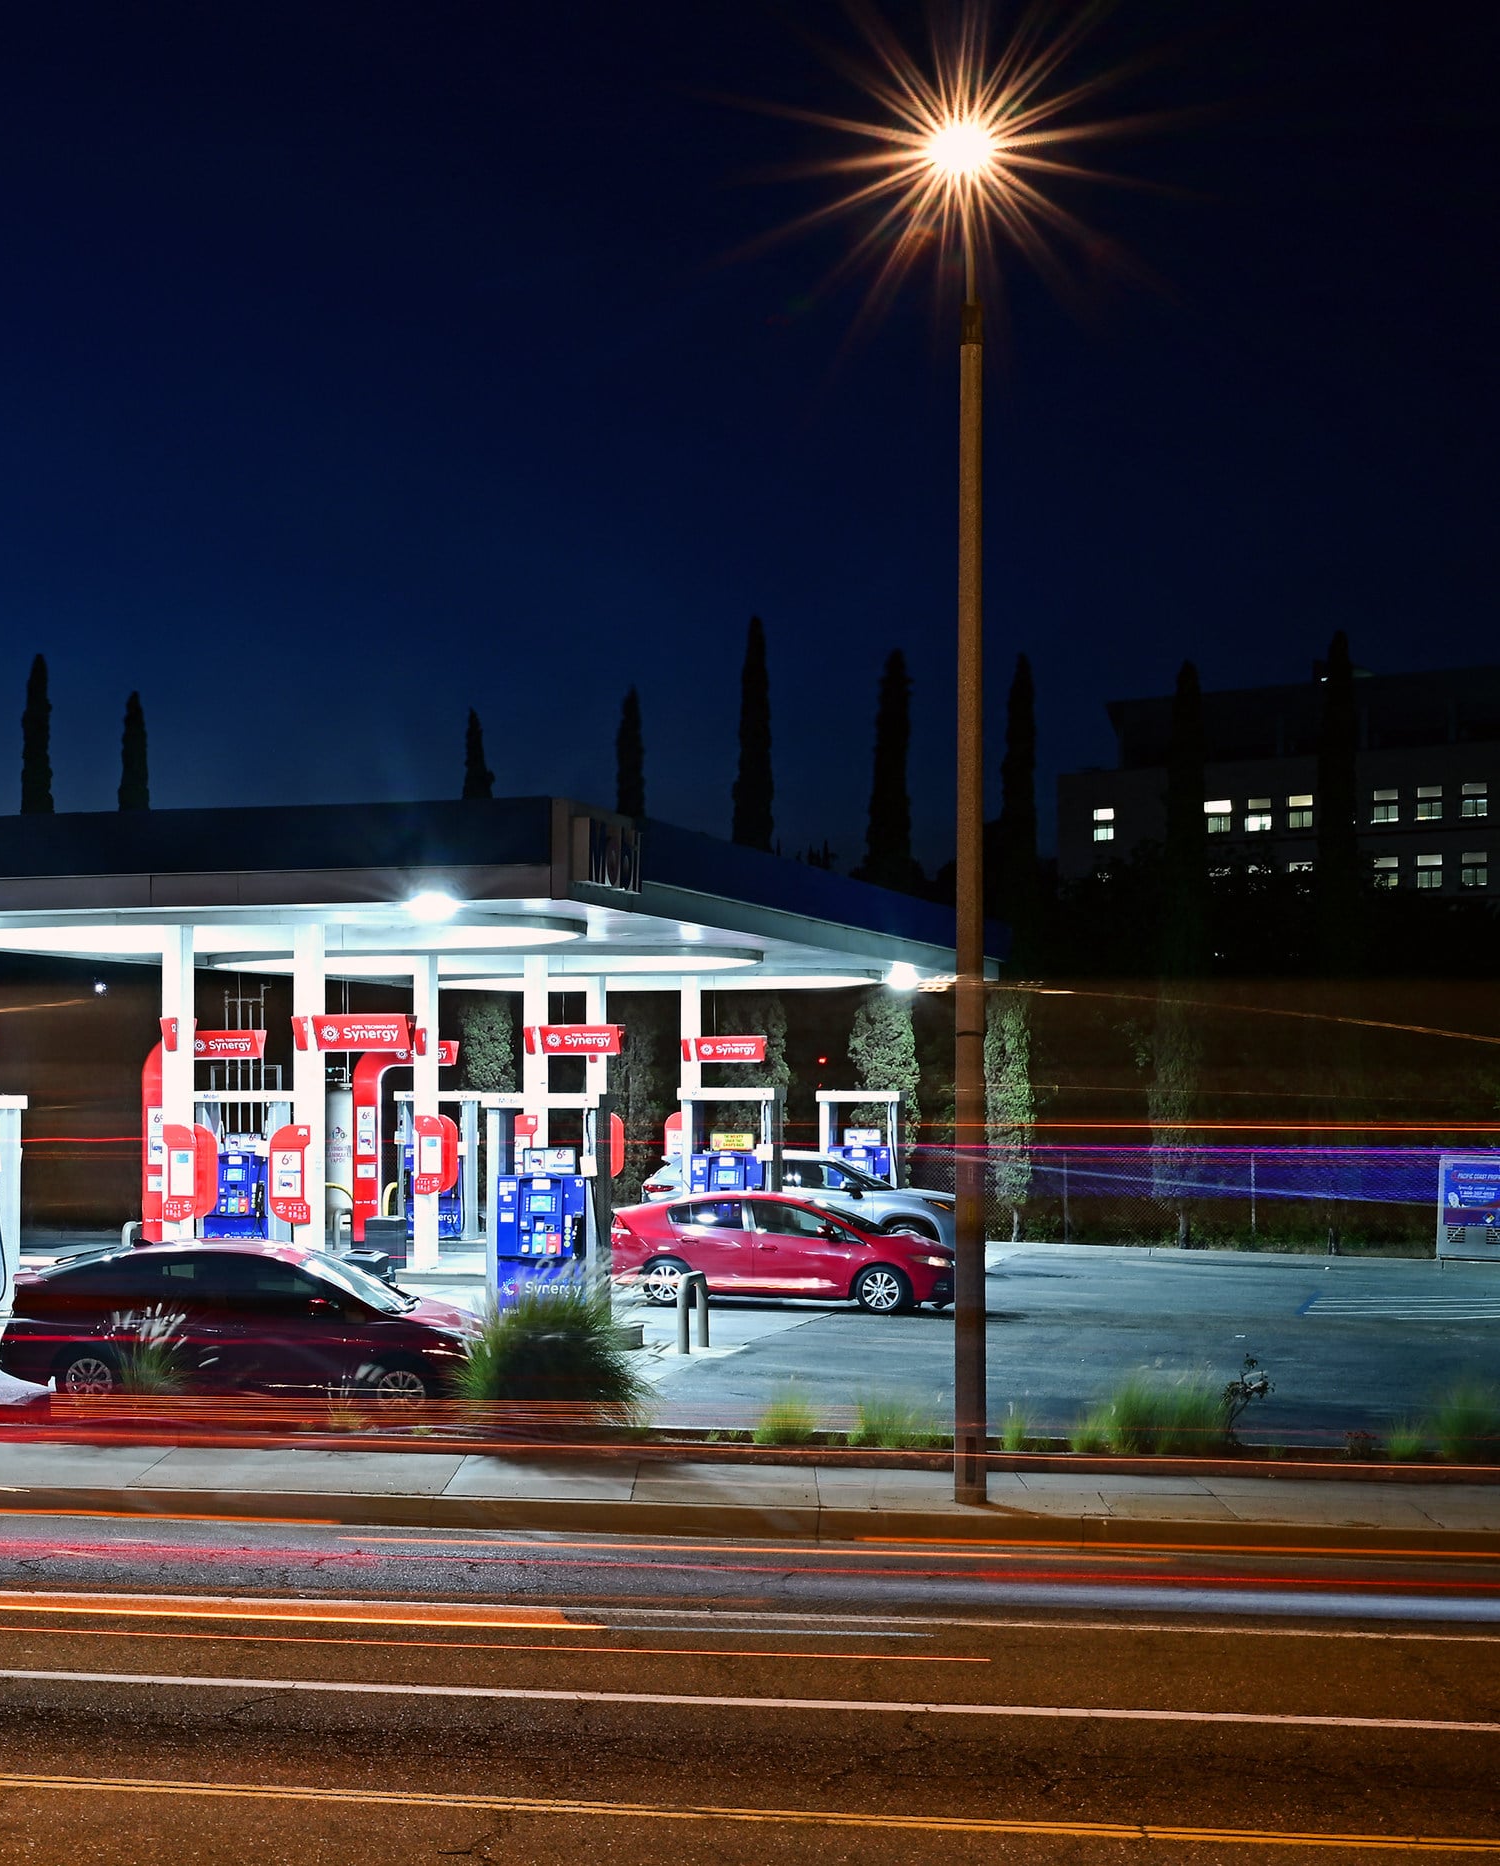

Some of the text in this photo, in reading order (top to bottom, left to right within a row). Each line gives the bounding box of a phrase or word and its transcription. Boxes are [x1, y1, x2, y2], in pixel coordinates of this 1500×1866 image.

[343, 1028, 399, 1042] Synergy
[209, 1040, 251, 1052] Synergy
[565, 1036, 611, 1047] Synergy
[716, 1045, 756, 1055] Synergy
[574, 1179, 583, 1187] 10
